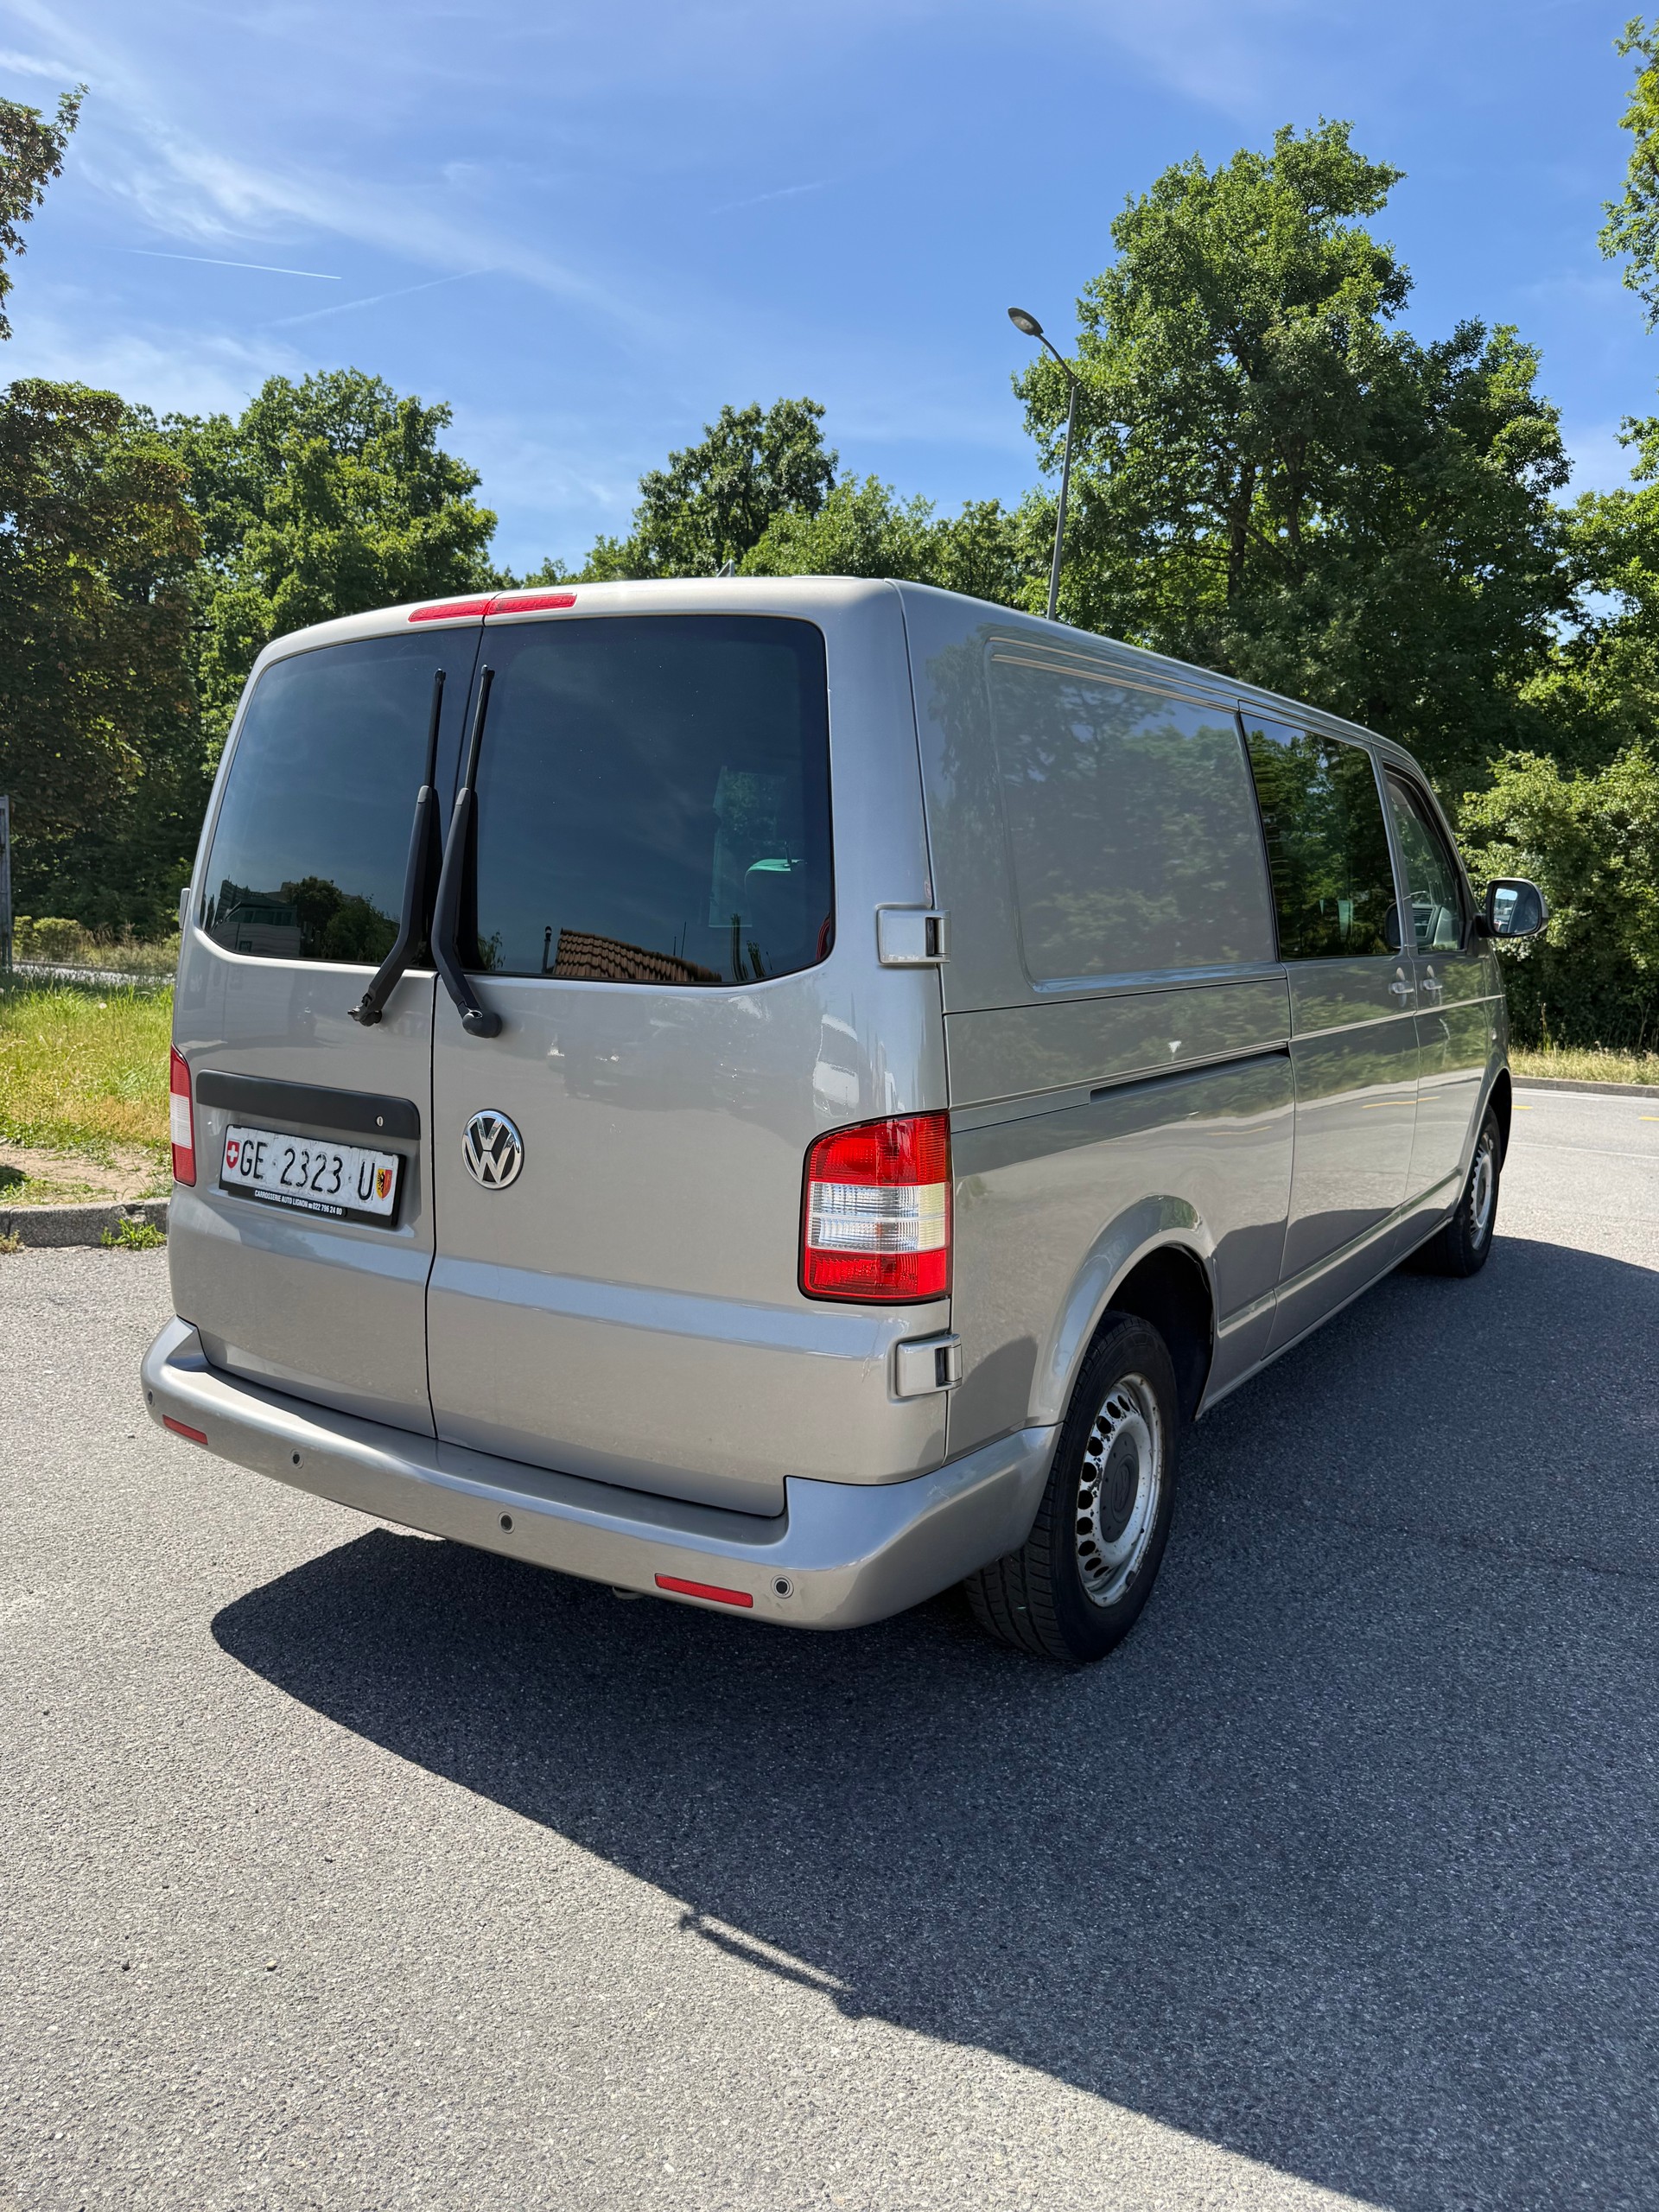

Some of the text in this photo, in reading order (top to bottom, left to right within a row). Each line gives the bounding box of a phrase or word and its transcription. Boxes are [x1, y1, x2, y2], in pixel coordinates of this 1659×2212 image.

[239, 1139, 375, 1201] GE 2323 U
[462, 1109, 521, 1189] VW
[254, 1189, 282, 1202] CARROSSERIE
[282, 1195, 293, 1205] AUTO
[292, 1198, 308, 1208] LIGNON
[312, 1202, 321, 1211] 022
[329, 1205, 336, 1214] 24
